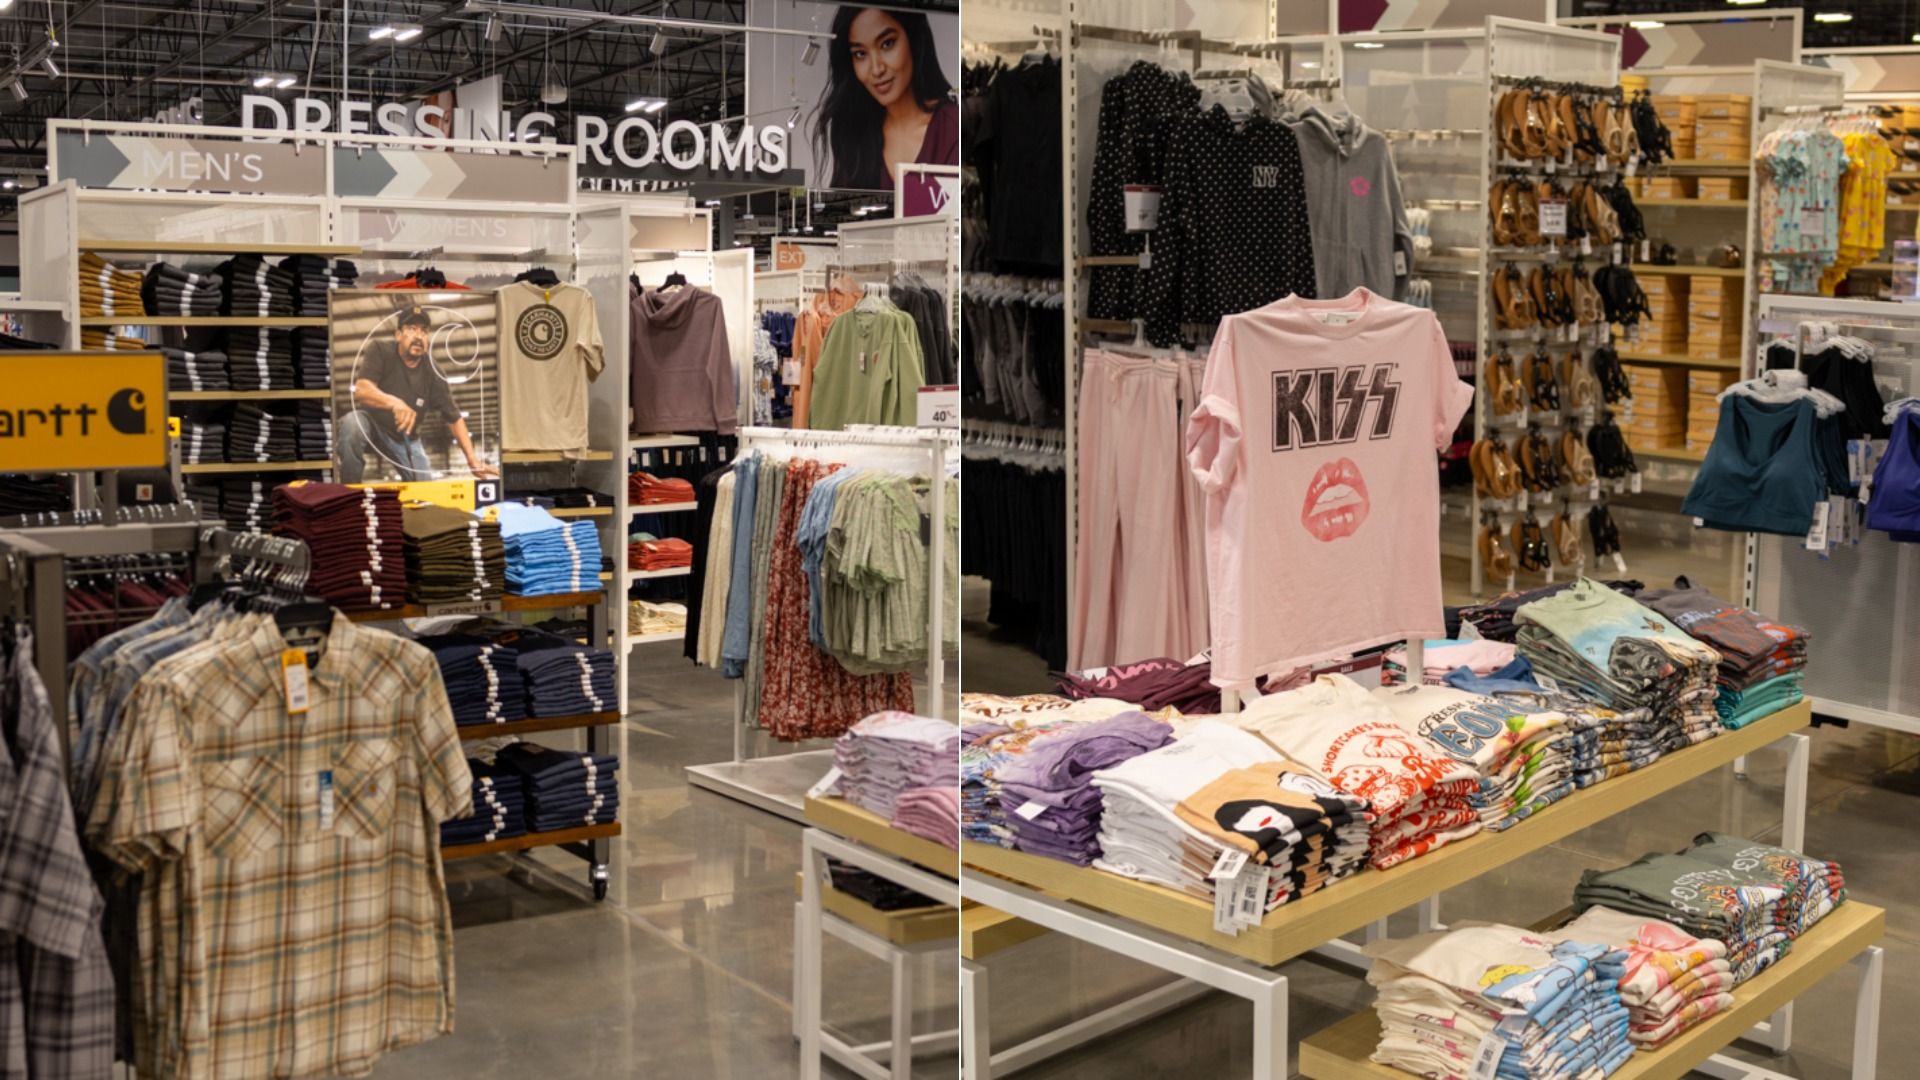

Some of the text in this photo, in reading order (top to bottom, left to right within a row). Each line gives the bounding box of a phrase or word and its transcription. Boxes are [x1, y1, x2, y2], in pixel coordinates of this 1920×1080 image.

[242, 94, 557, 158] DRESSING
[576, 114, 787, 174] ROOMS
[143, 152, 263, 183] MEN'S
[1252, 165, 1279, 188] NY
[385, 214, 508, 238] WOMEN'S
[1272, 363, 1402, 453] KISS
[1417, 700, 1466, 738] FRESH
